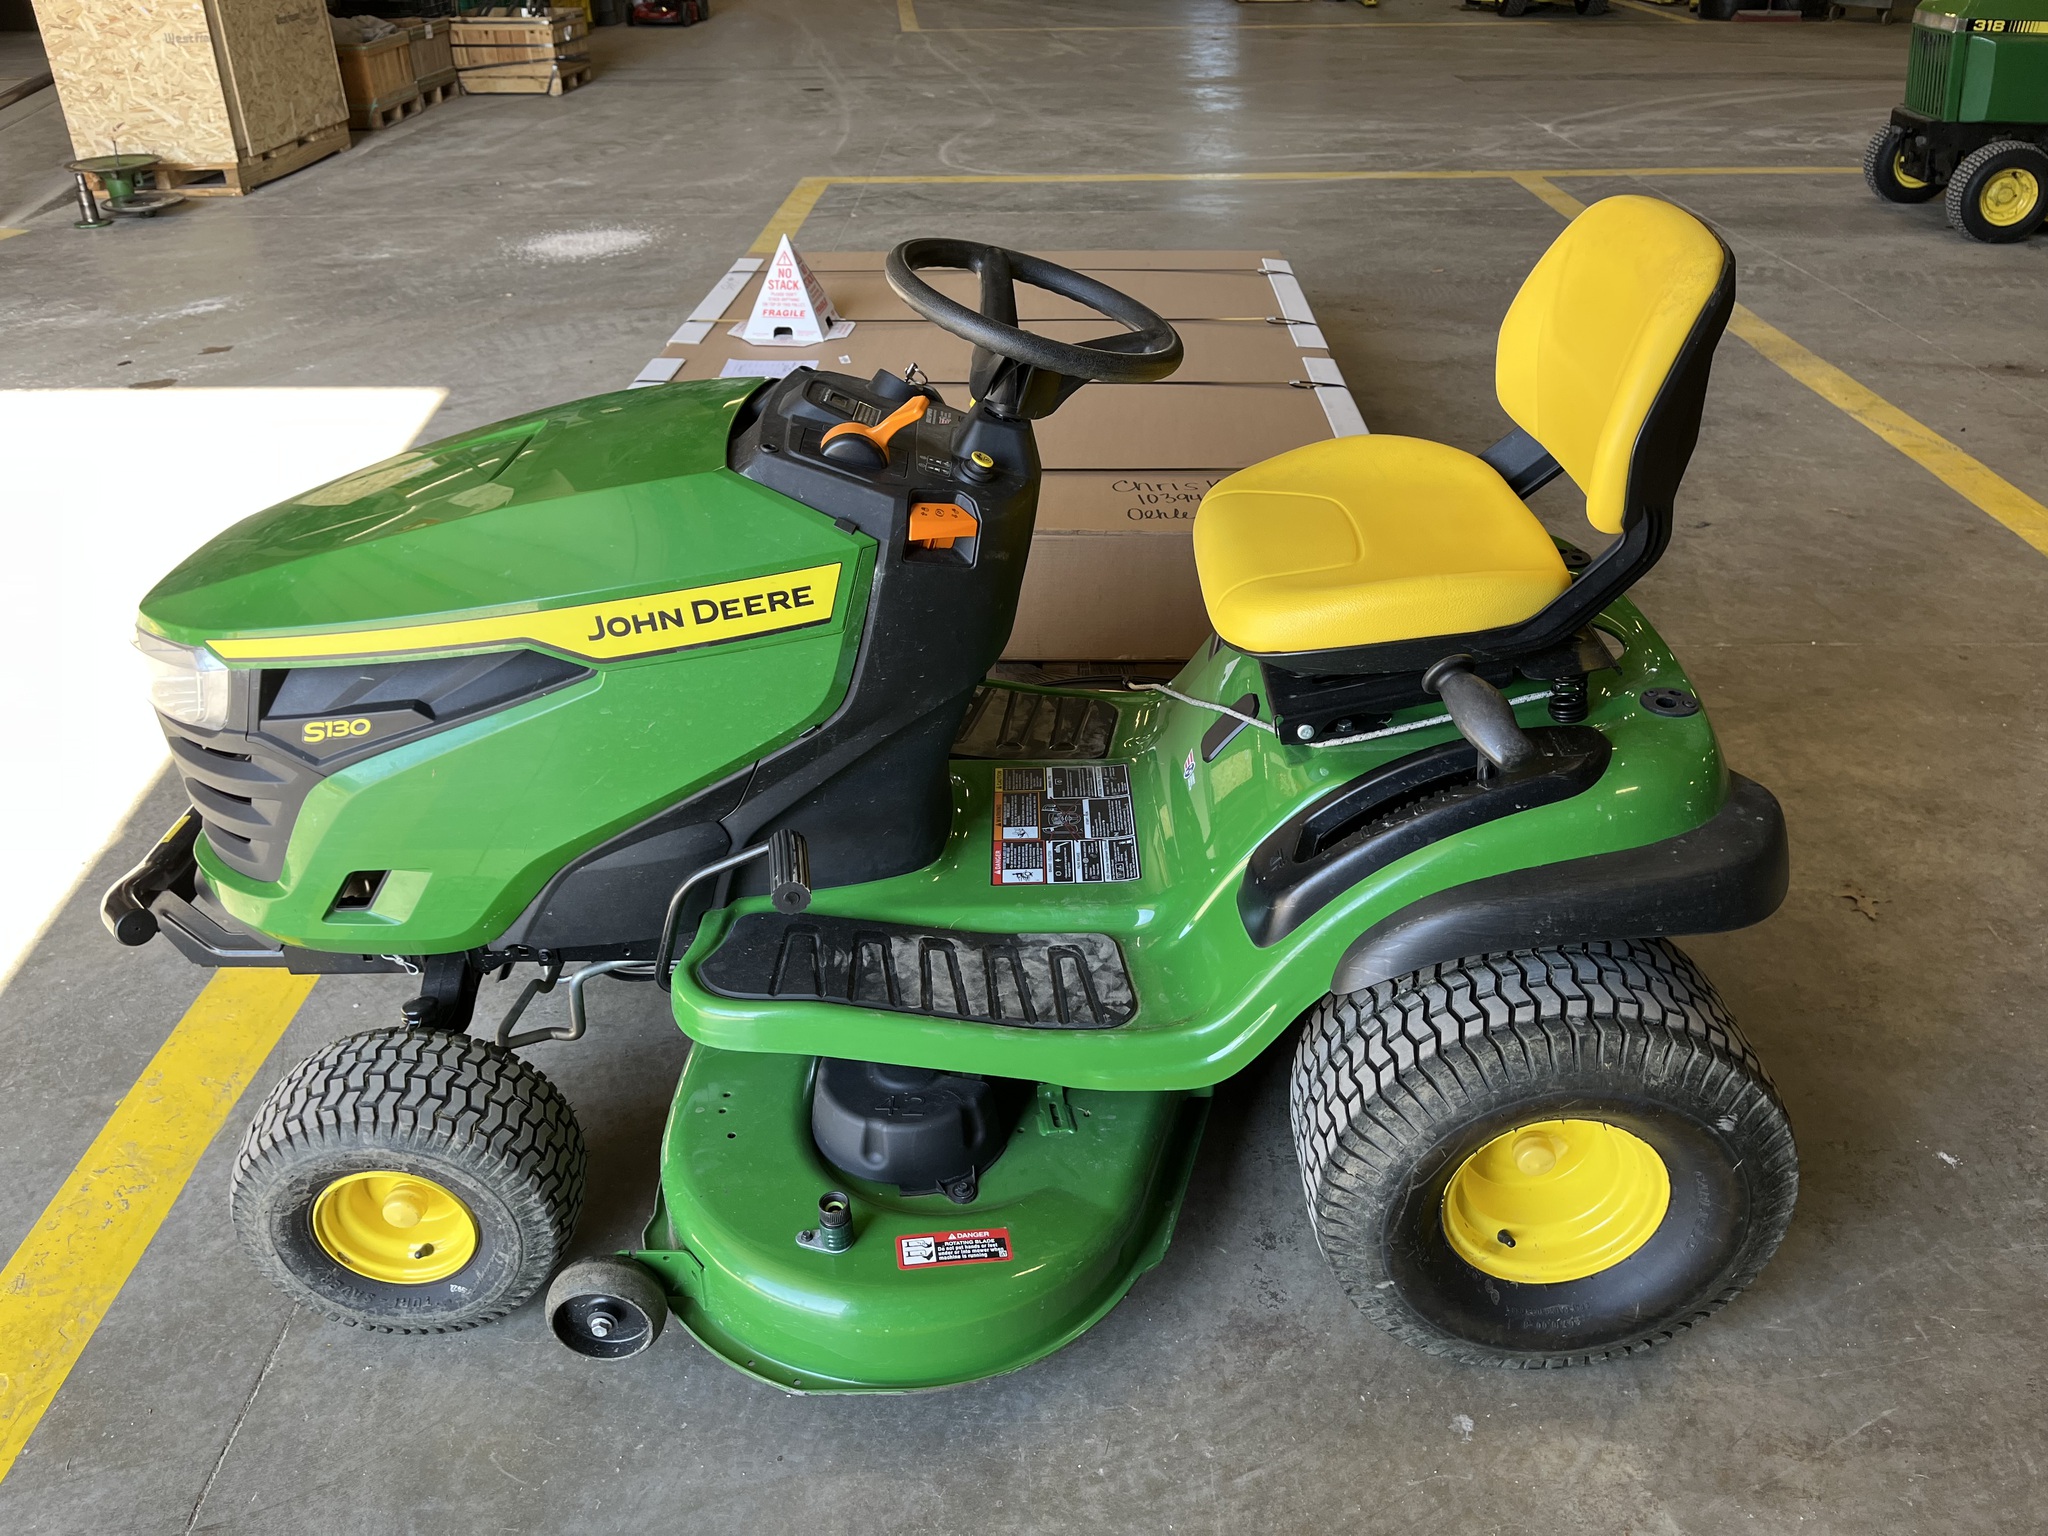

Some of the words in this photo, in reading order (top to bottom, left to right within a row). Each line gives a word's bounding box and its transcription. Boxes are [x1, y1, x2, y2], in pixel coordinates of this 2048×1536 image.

[1973, 19, 2005, 31] 318
[777, 268, 792, 278] NO
[768, 279, 800, 290] STACK
[762, 309, 806, 317] FRAGILE
[588, 608, 684, 641] JOHN
[691, 585, 814, 625] DEERE
[303, 718, 371, 742] S130
[875, 1095, 924, 1116] 42
